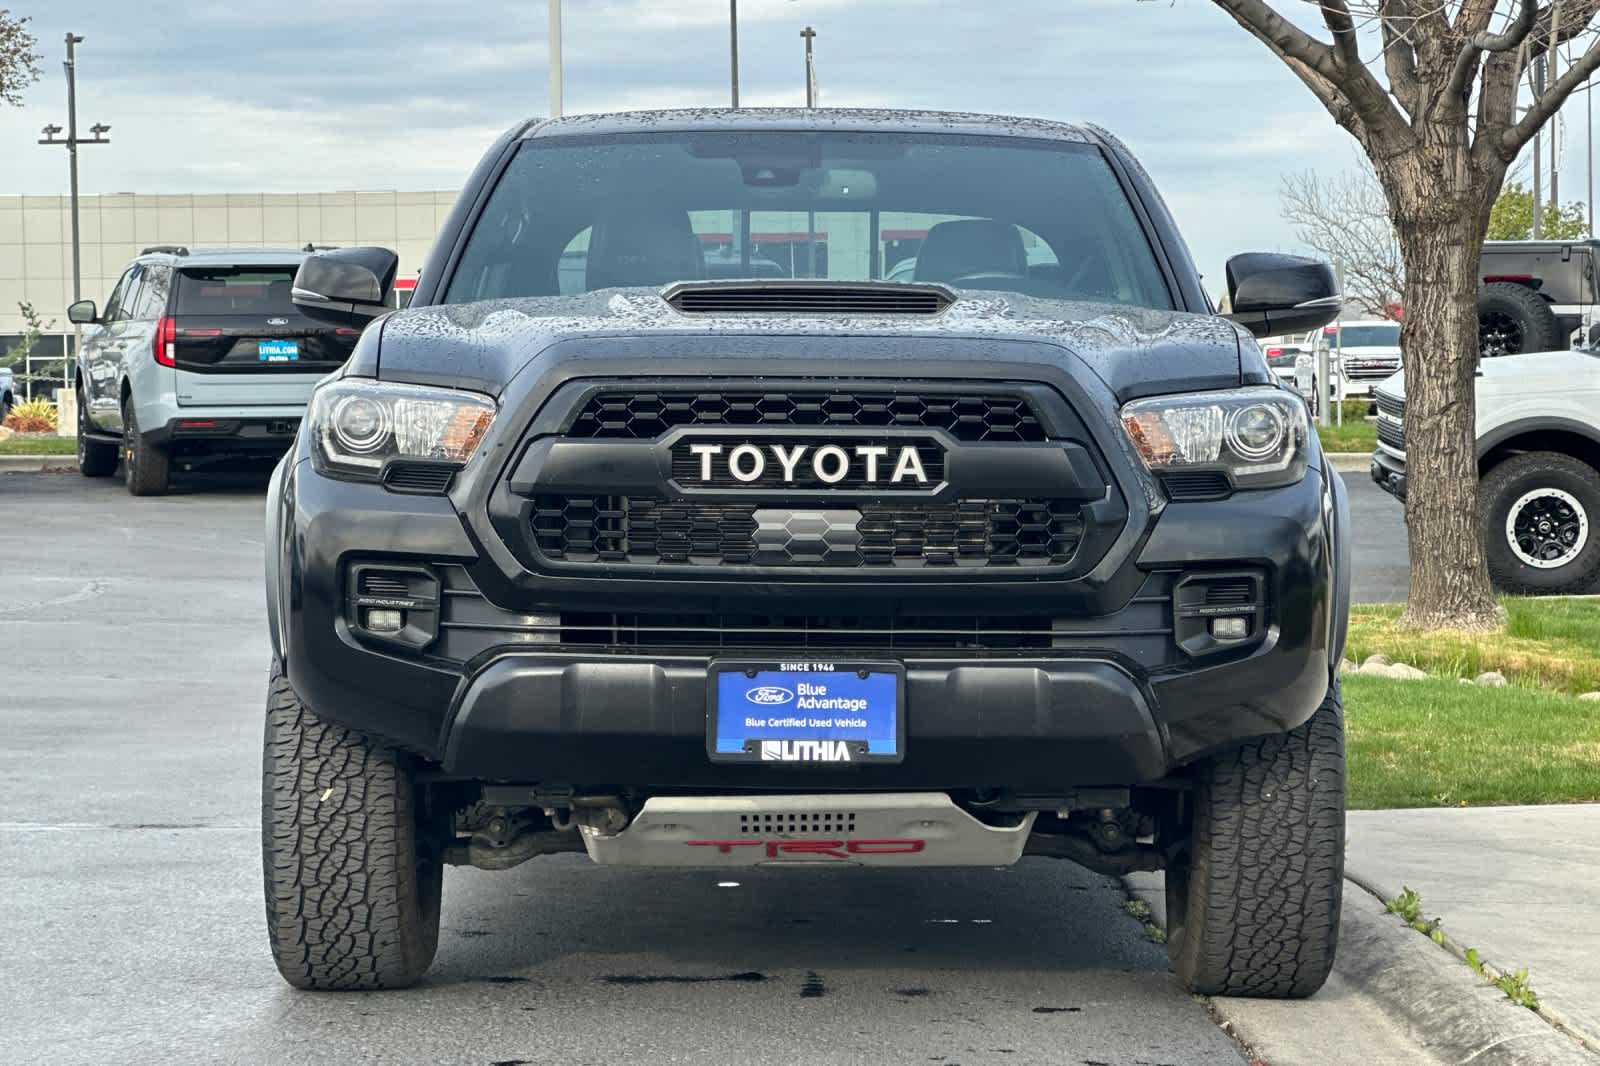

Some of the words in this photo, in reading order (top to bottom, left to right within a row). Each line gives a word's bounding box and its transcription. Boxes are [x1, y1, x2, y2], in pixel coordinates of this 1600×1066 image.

[690, 443, 928, 483] TOYOTA
[780, 663, 810, 672] SINCE
[812, 663, 835, 672] 1946
[754, 687, 786, 702] Ford
[797, 683, 827, 696] Blue
[797, 697, 868, 712] Advantage
[745, 718, 766, 727] Blue
[768, 718, 806, 727] Certified
[808, 718, 832, 728] Used
[834, 718, 867, 728] Vehicle
[782, 740, 851, 761] LITHIA
[685, 839, 926, 858] TRD
